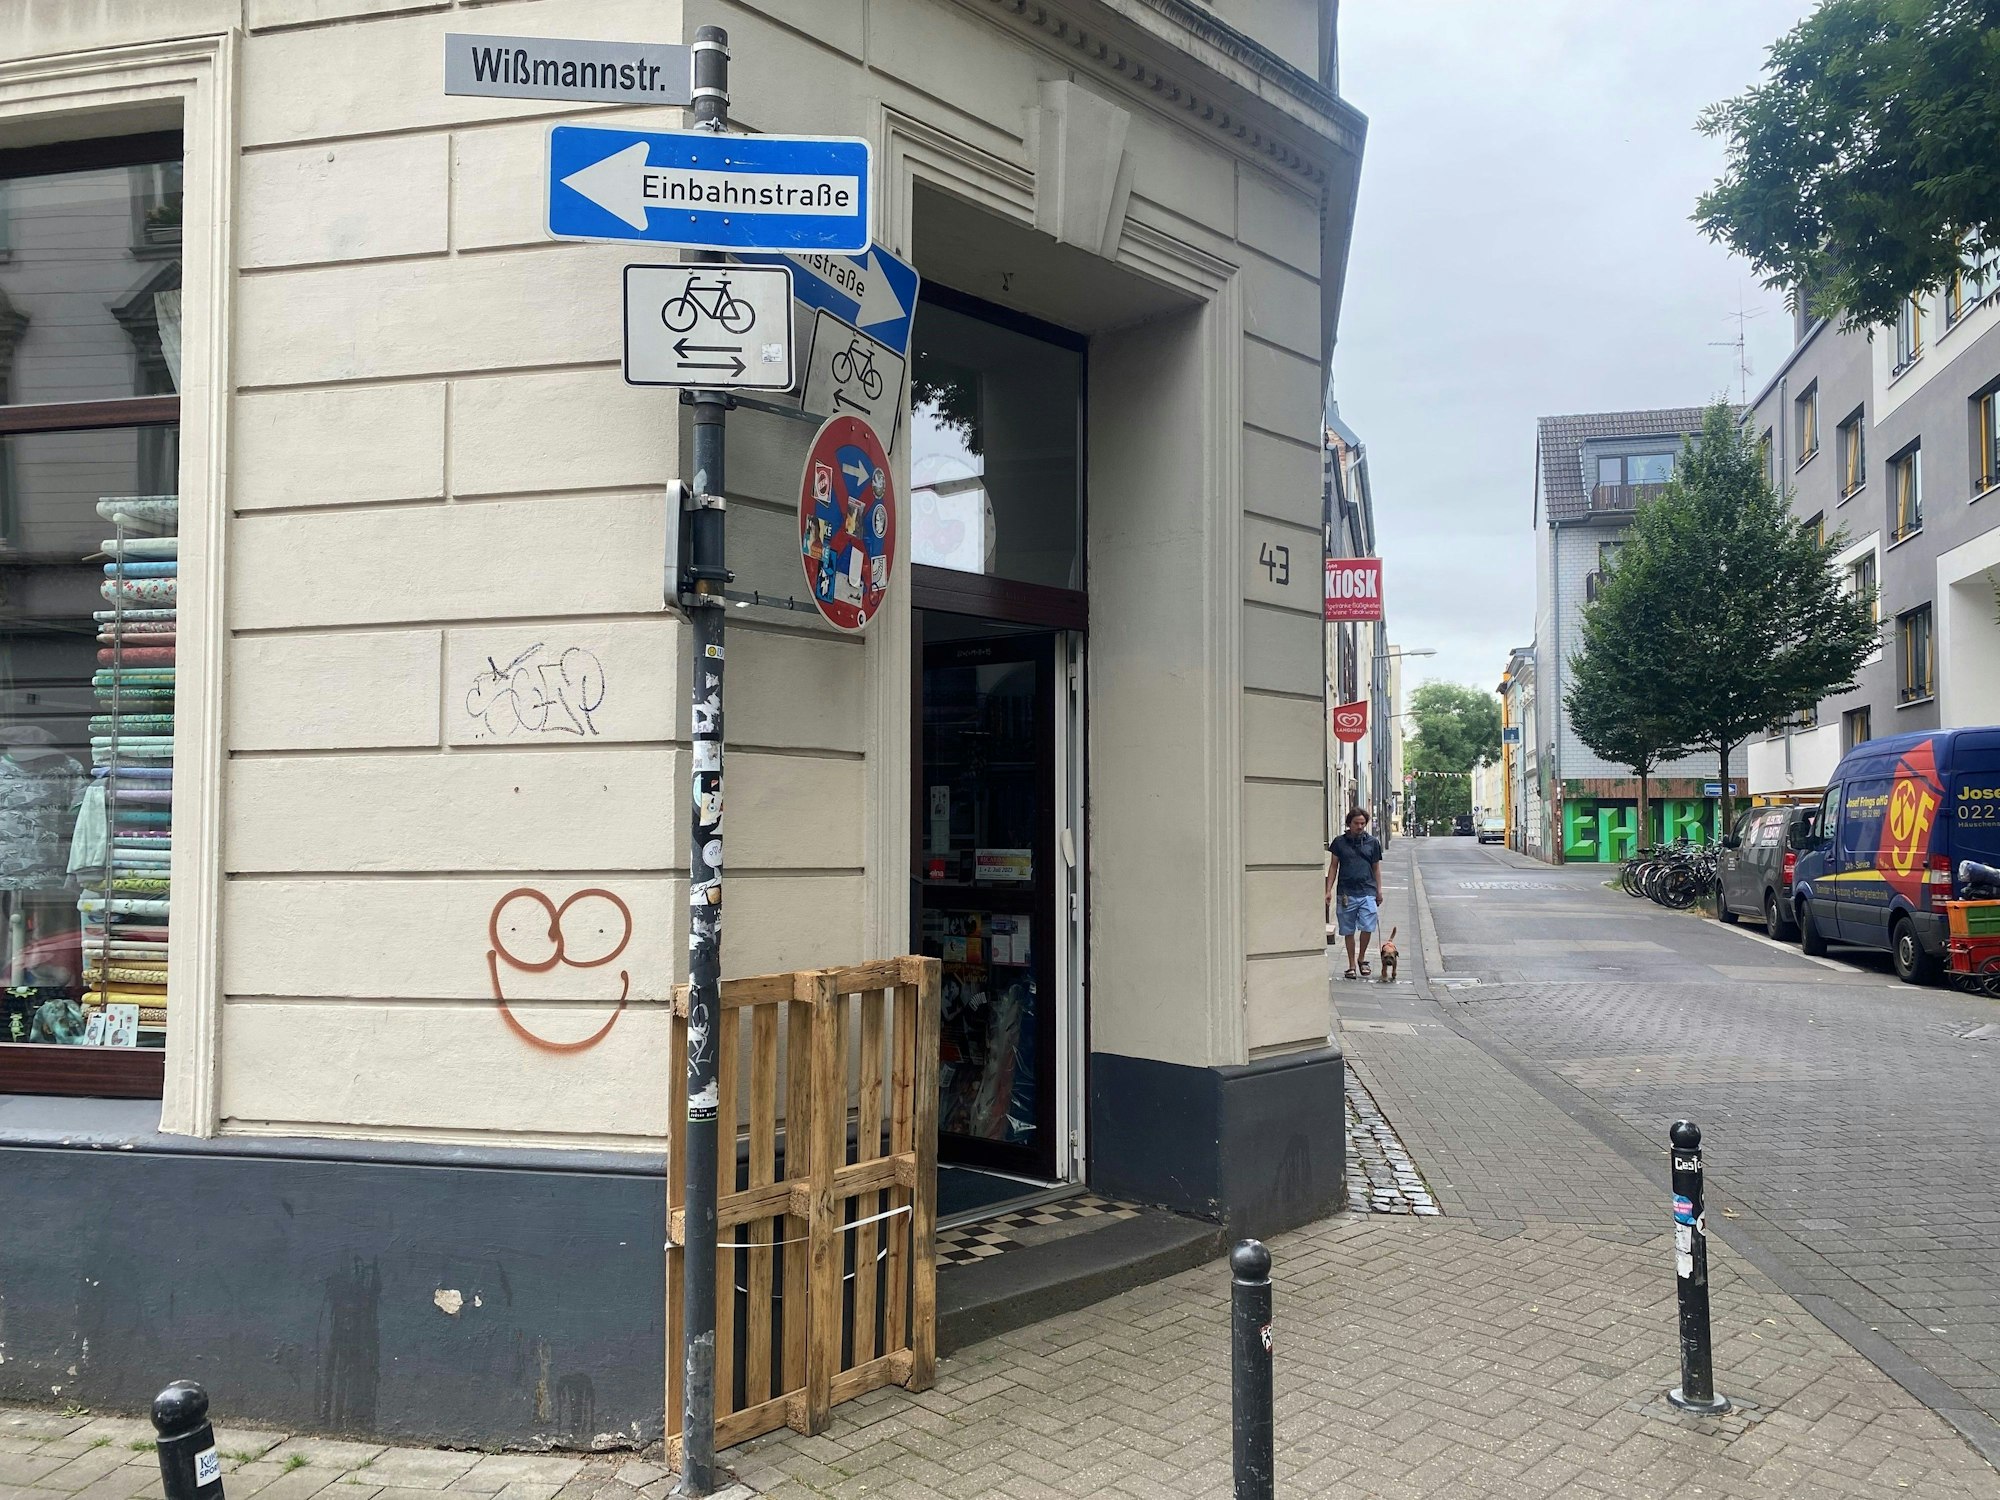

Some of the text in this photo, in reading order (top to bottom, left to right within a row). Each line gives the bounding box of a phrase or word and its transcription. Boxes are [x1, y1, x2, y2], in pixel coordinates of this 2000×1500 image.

[471, 47, 665, 91] Wißmannstr.
[643, 175, 849, 207] Einbahnstraße
[1259, 542, 1289, 585] 43
